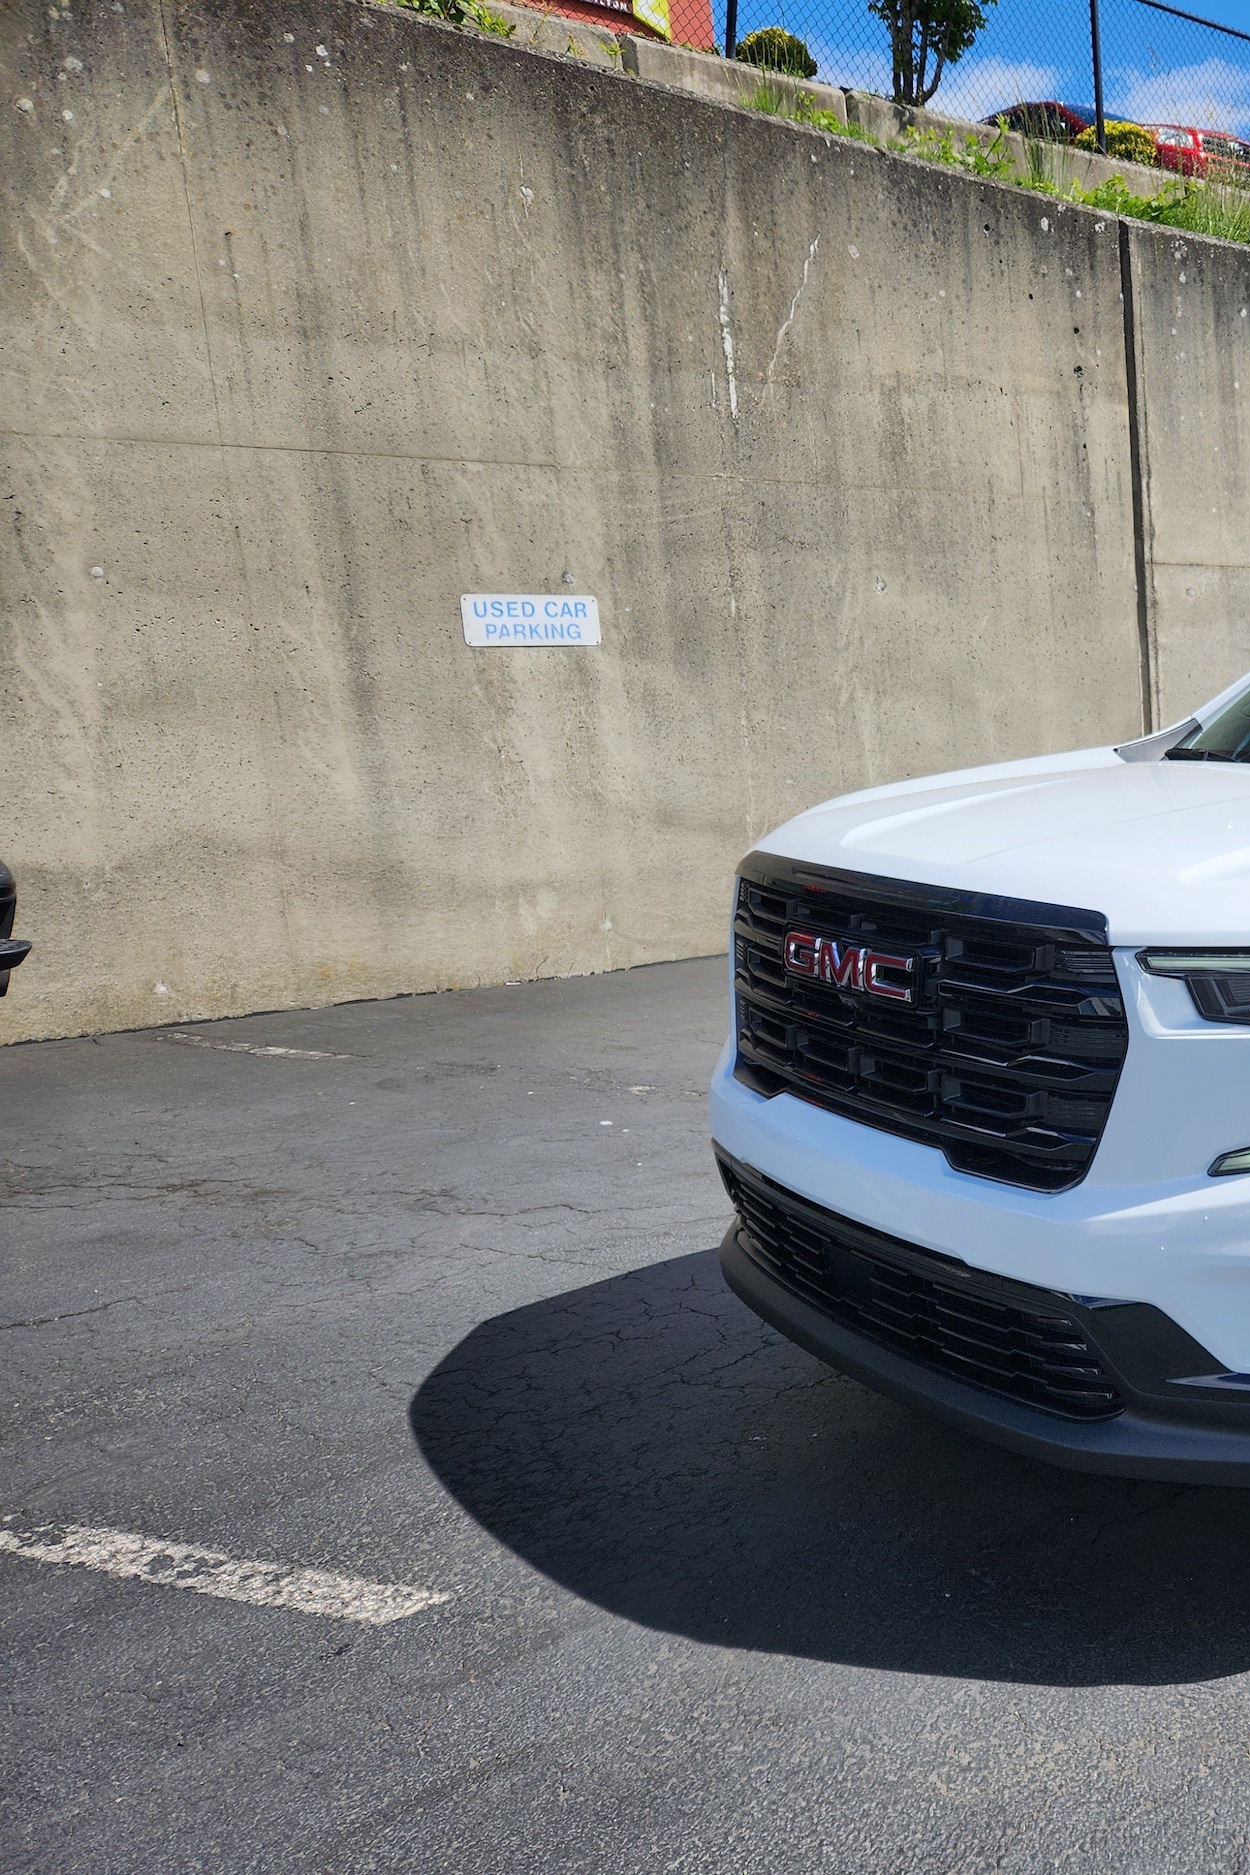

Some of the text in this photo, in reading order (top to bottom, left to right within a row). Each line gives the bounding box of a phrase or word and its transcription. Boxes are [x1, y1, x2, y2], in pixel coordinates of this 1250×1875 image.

[472, 600, 588, 618] USED CAR
[484, 623, 582, 639] PARKING
[784, 931, 914, 1002] GMC
